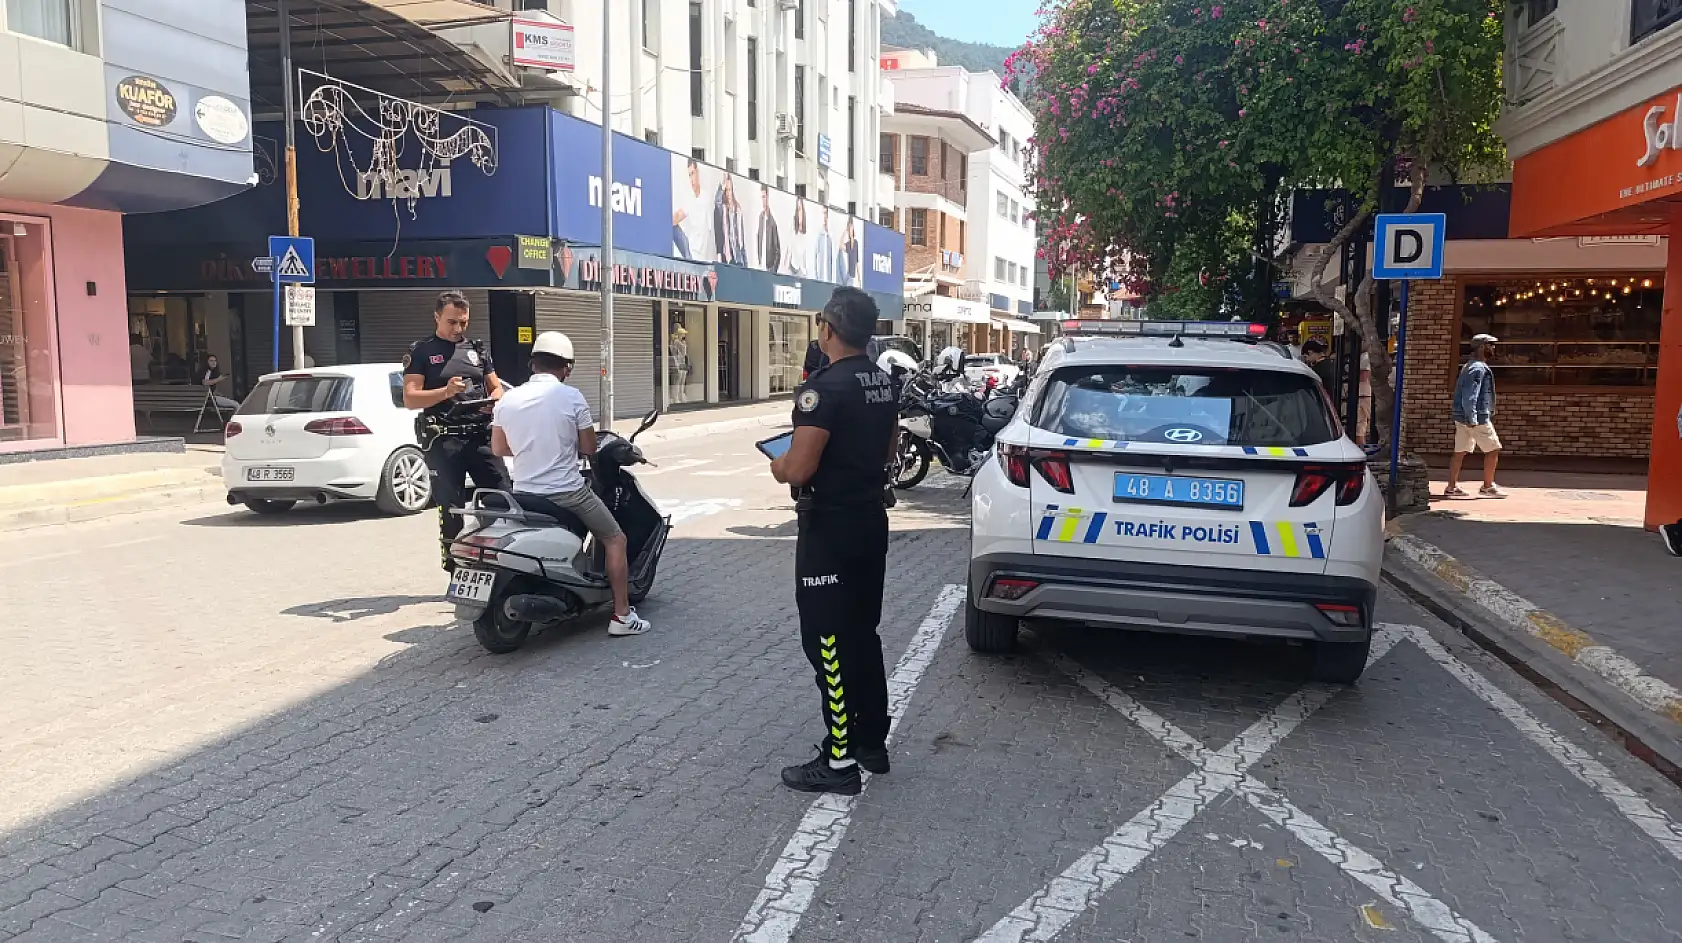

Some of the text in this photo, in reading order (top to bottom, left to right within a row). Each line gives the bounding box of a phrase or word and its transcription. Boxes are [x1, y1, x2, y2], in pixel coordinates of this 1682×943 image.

[524, 33, 549, 45] KMS
[119, 83, 174, 110] KUAFÖR
[357, 157, 452, 199] mavi
[524, 248, 547, 259] OFFICE
[1393, 229, 1423, 264] D
[316, 255, 449, 280] EWELLERY
[582, 254, 702, 293] DİMEN JEWELLERY
[872, 251, 892, 275] mavi
[772, 282, 802, 305] mavi
[264, 469, 270, 480] R
[1127, 478, 1239, 503] 48 A 8356
[1114, 519, 1239, 544] TRAFİK POLİSİ
[454, 569, 492, 586] 48 AFR
[456, 583, 479, 598] 611
